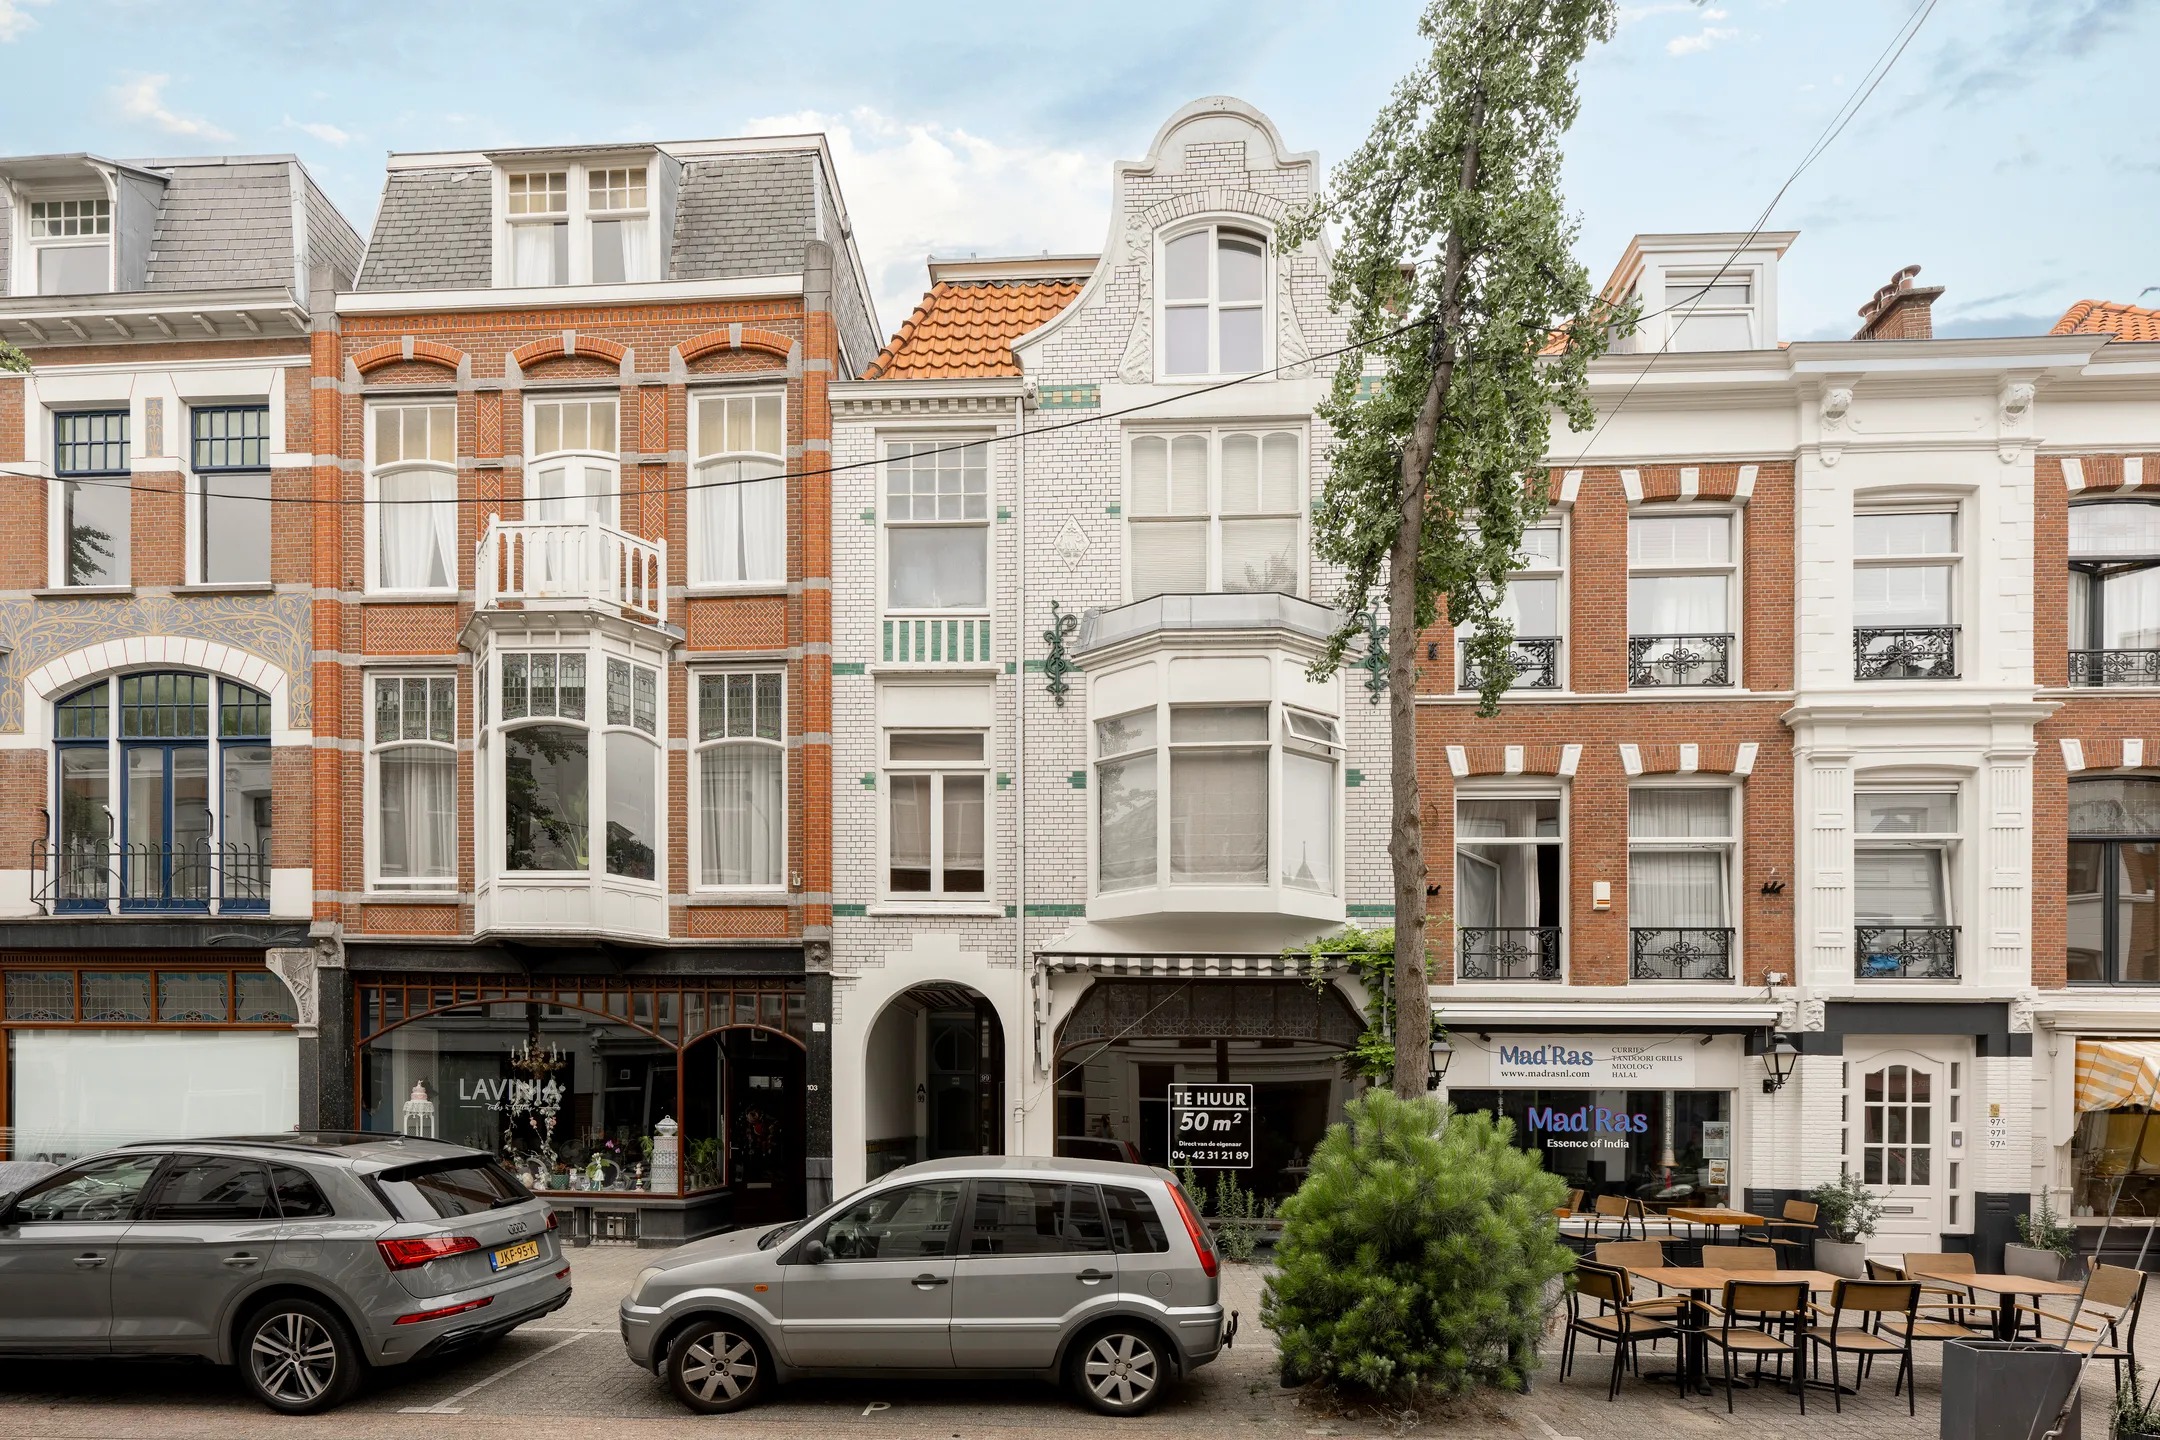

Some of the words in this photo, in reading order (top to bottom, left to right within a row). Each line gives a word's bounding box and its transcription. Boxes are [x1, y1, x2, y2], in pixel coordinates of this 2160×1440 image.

[1501, 1069, 1590, 1078] www.madrasnl.com
[459, 1078, 562, 1101] LAVINIA
[1174, 1092, 1193, 1106] TE
[1196, 1092, 1247, 1106] HUUR
[1179, 1112, 1210, 1131] 50
[1547, 1139, 1588, 1148] Essence
[1590, 1139, 1602, 1148] of
[1604, 1139, 1630, 1149] India
[1207, 1151, 1219, 1160] 31
[1221, 1151, 1233, 1160] 21
[1235, 1151, 1249, 1160] 89
[861, 1401, 891, 1416] P
